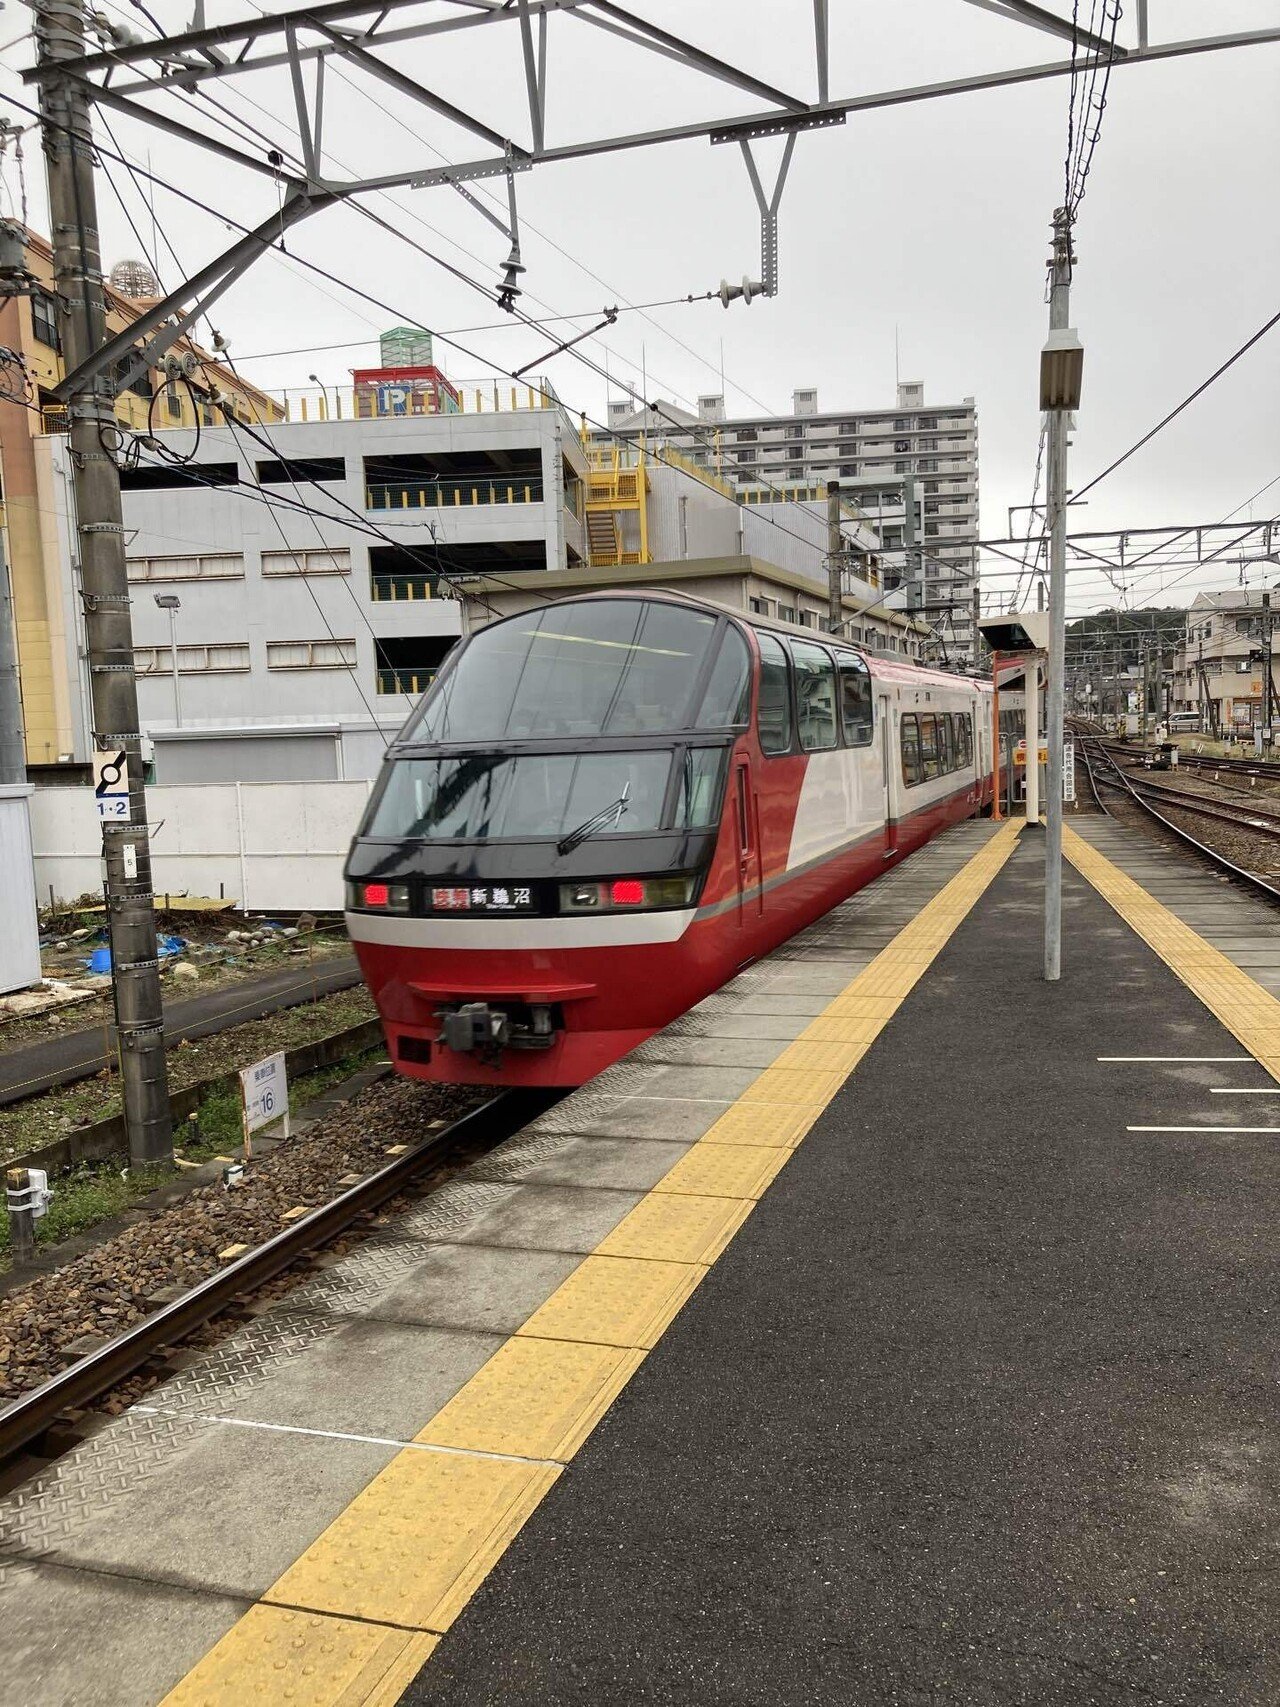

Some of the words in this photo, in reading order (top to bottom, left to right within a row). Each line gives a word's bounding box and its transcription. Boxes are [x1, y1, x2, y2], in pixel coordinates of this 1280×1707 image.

[384, 390, 406, 410] P
[471, 888, 531, 905] 新鵜沼
[261, 1092, 274, 1113] 16
